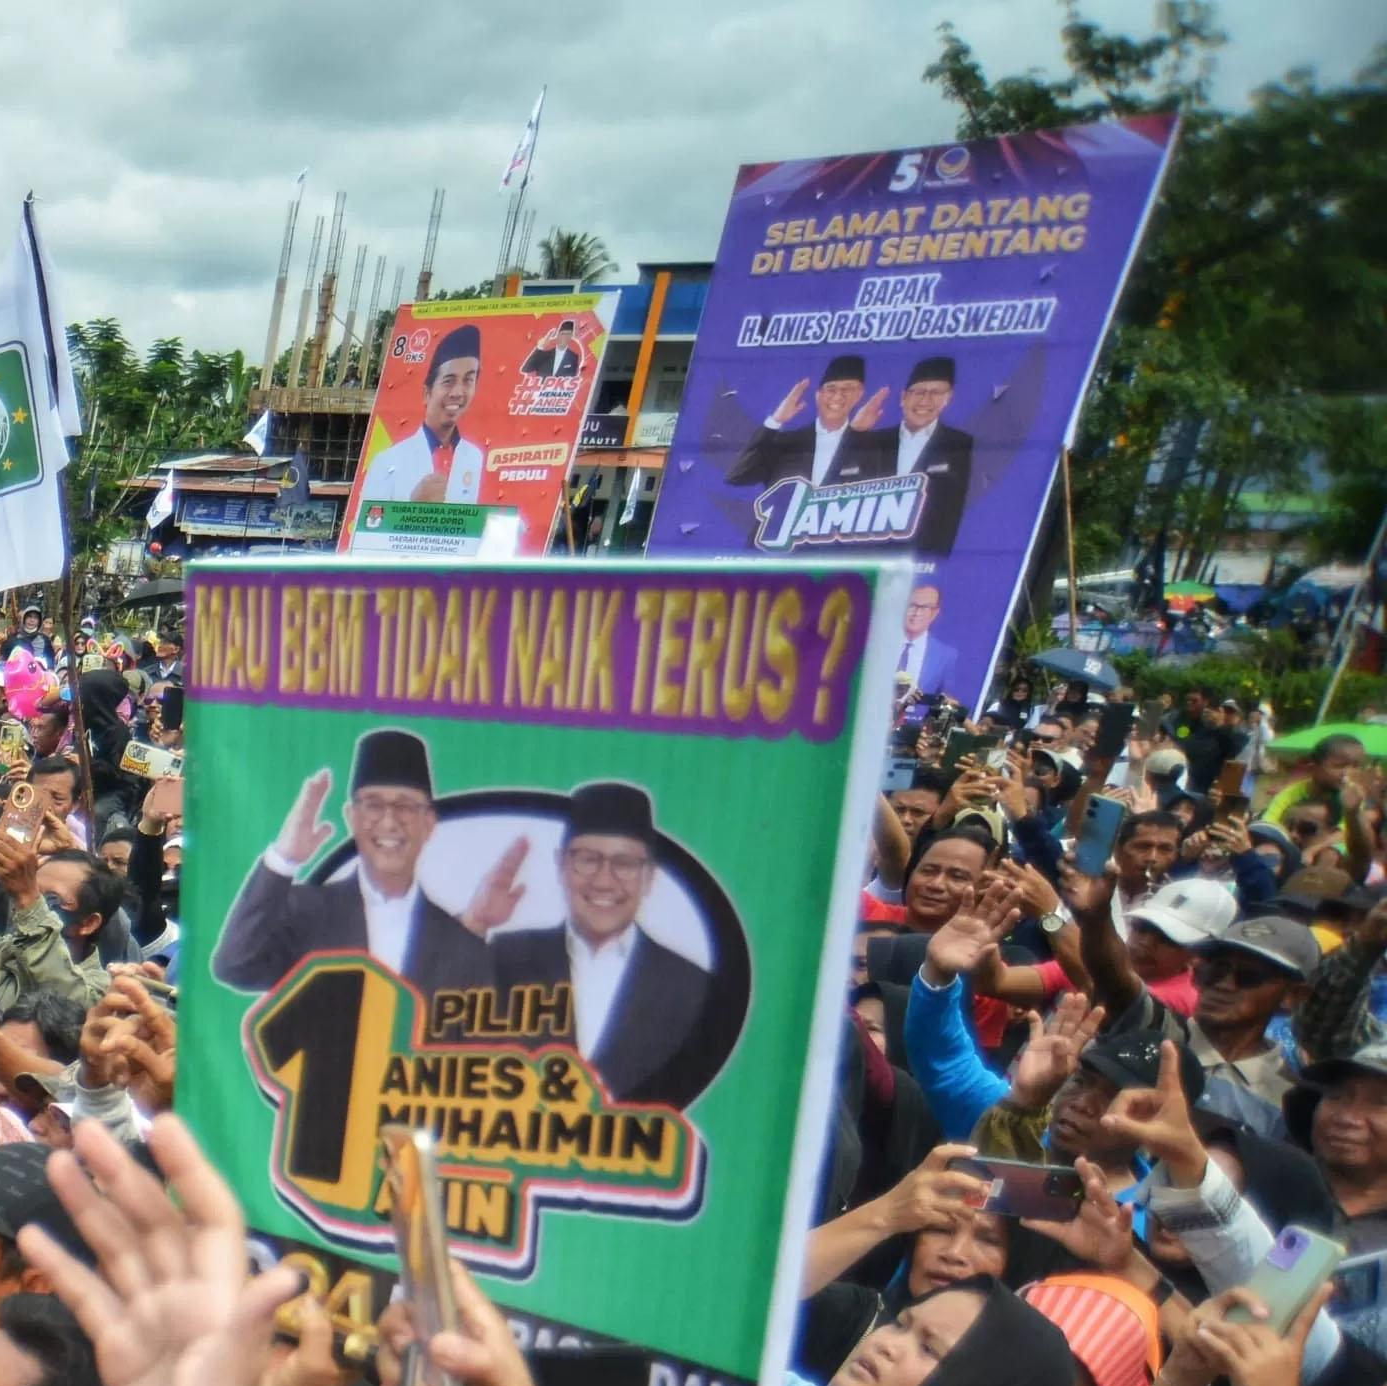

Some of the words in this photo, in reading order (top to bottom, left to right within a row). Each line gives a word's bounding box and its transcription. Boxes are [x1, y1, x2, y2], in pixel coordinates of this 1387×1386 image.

[888, 153, 923, 192] 5
[764, 206, 926, 247] SELAMAT
[930, 194, 1091, 231] DATANG
[750, 253, 784, 276] DI
[789, 240, 872, 273] BUMI
[876, 226, 1086, 267] SENENTANG
[858, 275, 939, 309] BAPAK
[738, 316, 762, 346] H.
[764, 313, 829, 345] ANIES
[829, 307, 916, 342] RASYID
[913, 298, 1057, 338] BASWEDAN
[392, 336, 407, 357] 8
[404, 352, 425, 362] PKS
[540, 376, 582, 392] PKS
[534, 398, 571, 407] ANIES
[538, 391, 574, 399] MENANG
[530, 405, 568, 415] PRESIDEN
[491, 447, 564, 466] ASPIRATIF
[499, 468, 549, 483] PEDULI
[849, 477, 919, 496] MUHAIMIN
[400, 515, 439, 524] ANGGOTA
[440, 517, 465, 525] DPRD
[418, 507, 446, 516] SUARA
[447, 508, 480, 517] PEMILU
[791, 490, 918, 537] AMIN
[393, 524, 468, 535] KABUPATEN/KOTA
[388, 535, 419, 543] DAERAH
[419, 537, 461, 546] PEMILIHAN
[191, 585, 271, 690] MAU
[278, 586, 365, 698] BBM
[375, 587, 497, 706] TIDAK
[503, 587, 623, 715] NAIK
[631, 587, 804, 723] TERUS
[812, 588, 855, 726] ?
[430, 981, 573, 1038] PILIH
[380, 1055, 526, 1101] ANIES
[538, 1057, 579, 1103] &
[378, 1103, 665, 1162] MUHAIMIN
